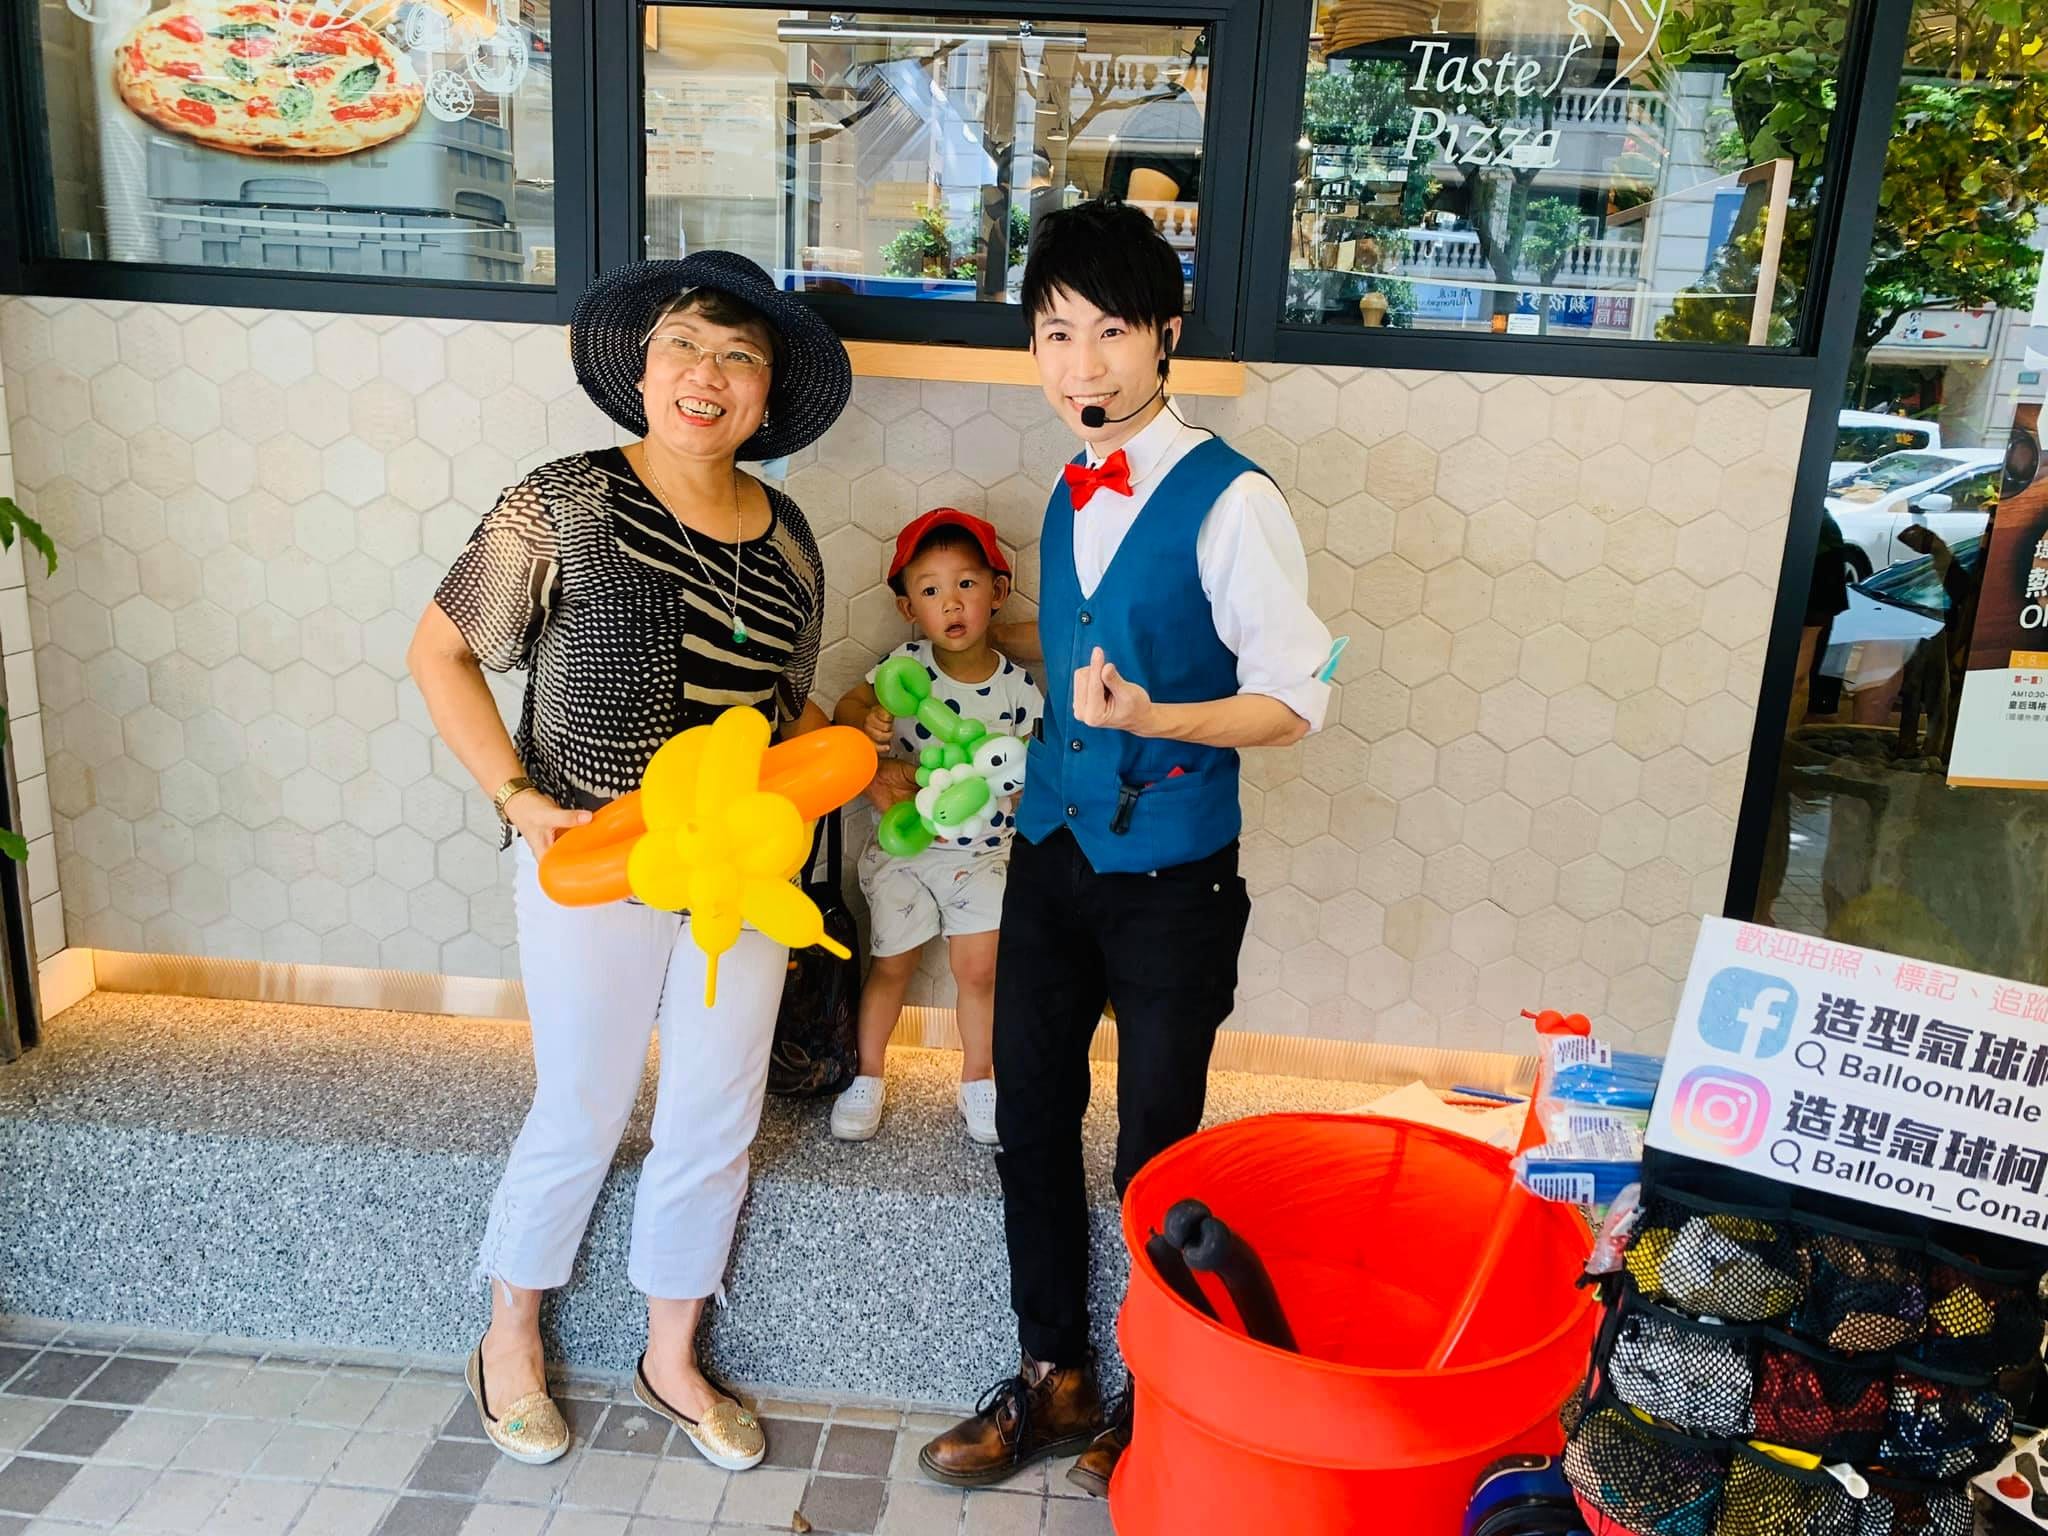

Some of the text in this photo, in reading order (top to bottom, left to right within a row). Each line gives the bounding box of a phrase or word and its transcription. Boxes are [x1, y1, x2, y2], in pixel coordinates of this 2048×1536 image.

[1409, 40, 1541, 97] Taste
[1398, 103, 1562, 168] Pizza
[1839, 1053, 2042, 1123] BalloonMale
[1782, 1090, 2048, 1196] 造型氣球柯
